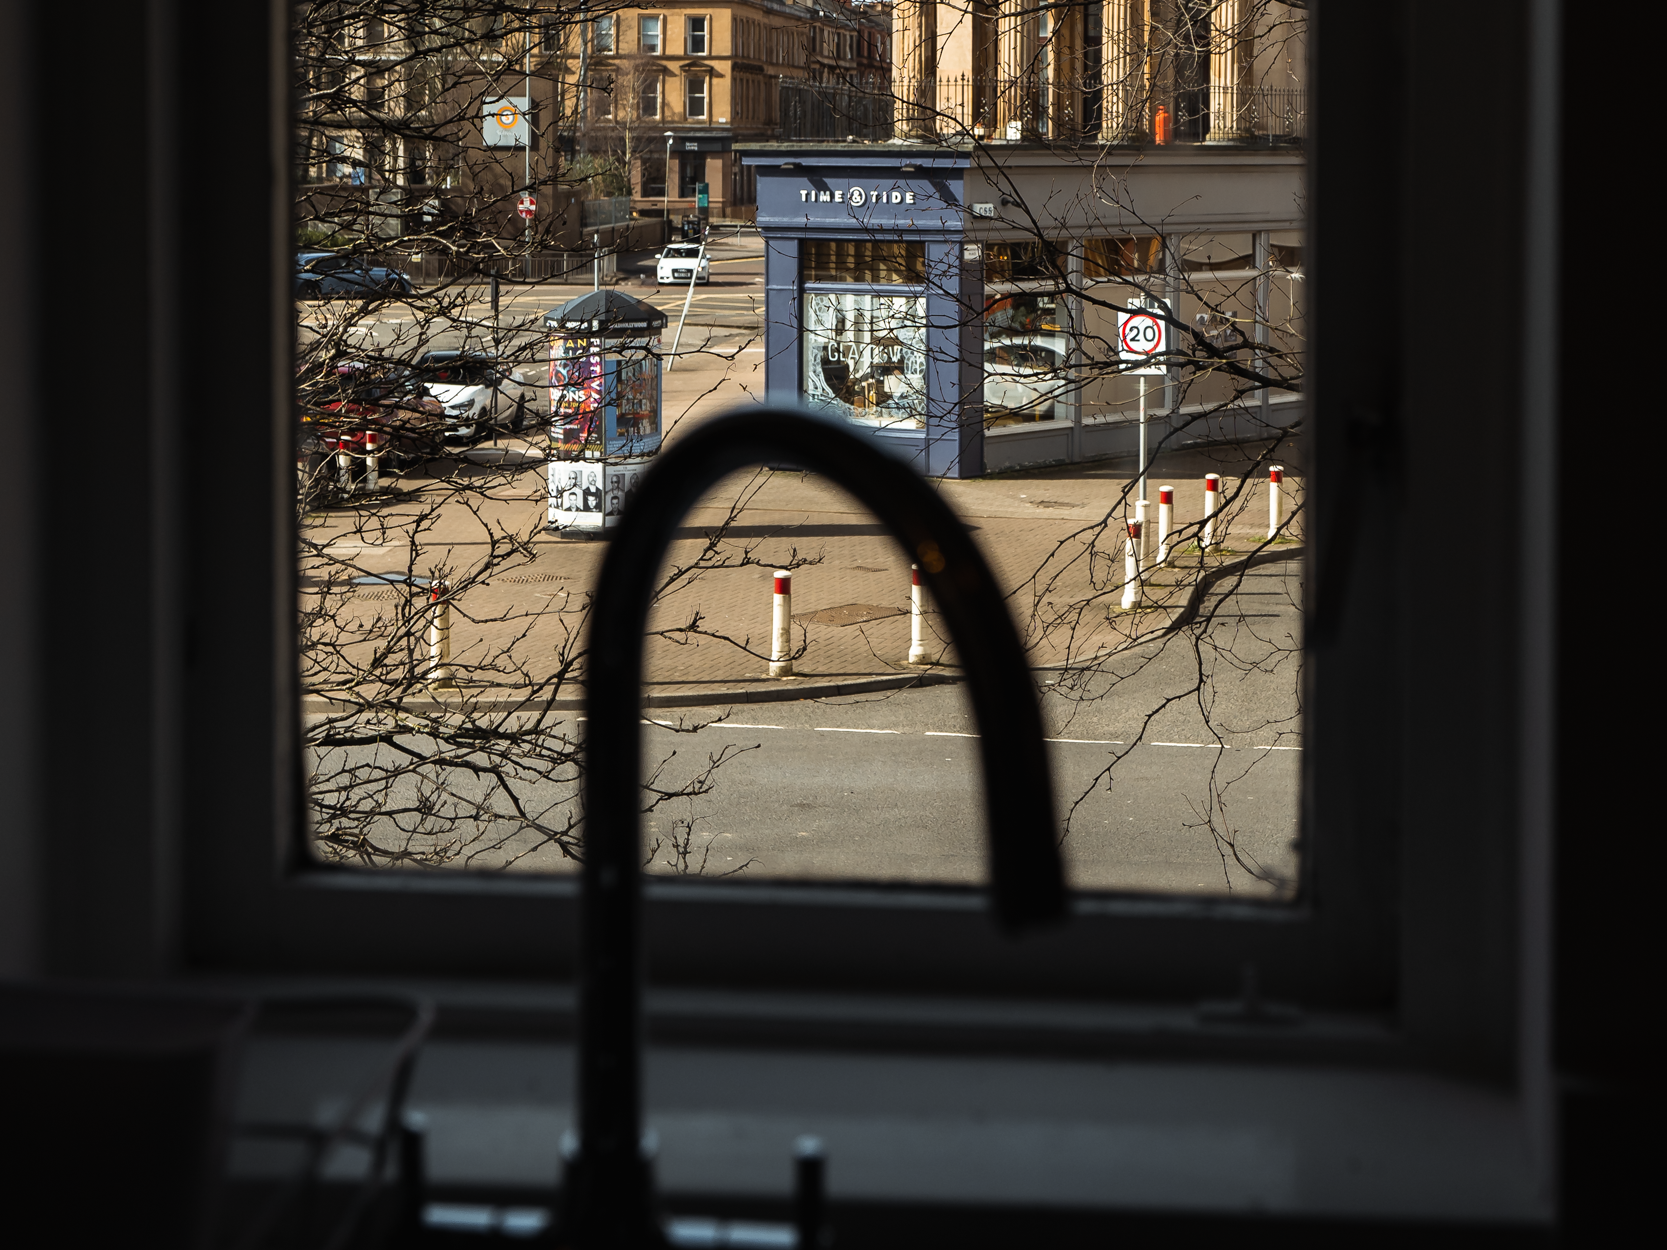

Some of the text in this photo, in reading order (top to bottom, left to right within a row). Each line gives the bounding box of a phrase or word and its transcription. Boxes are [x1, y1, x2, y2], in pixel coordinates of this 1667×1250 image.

[800, 189, 843, 202] TIME
[870, 190, 915, 204] TIDE
[1128, 325, 1156, 343] 20
[590, 338, 601, 411] FESTIVAL
